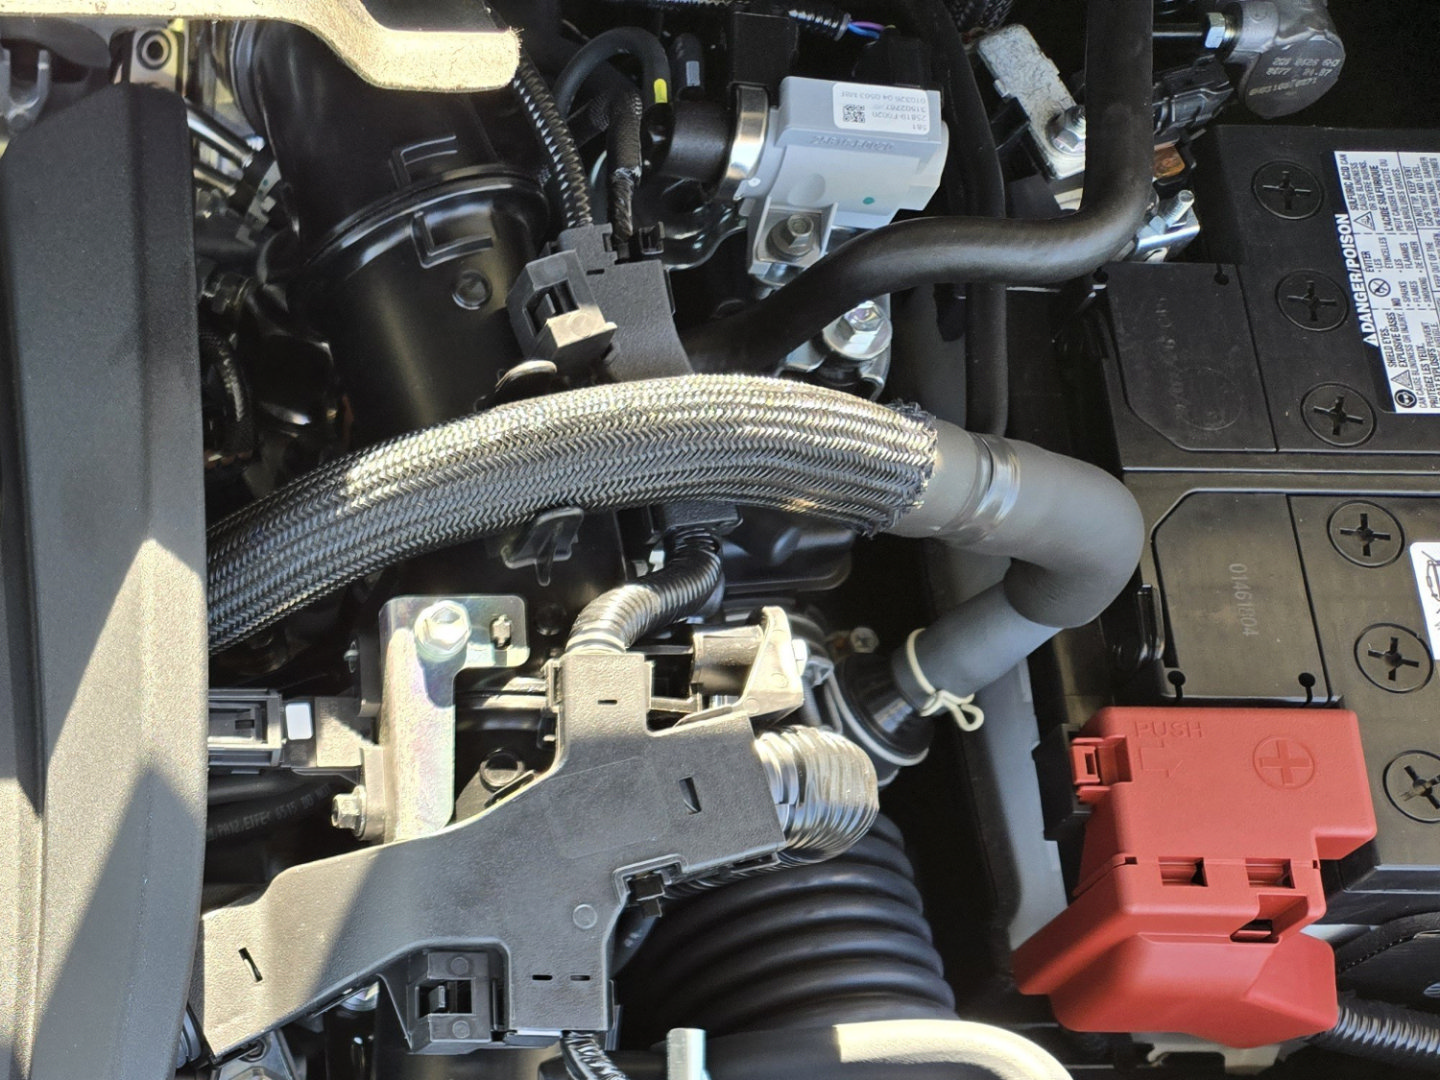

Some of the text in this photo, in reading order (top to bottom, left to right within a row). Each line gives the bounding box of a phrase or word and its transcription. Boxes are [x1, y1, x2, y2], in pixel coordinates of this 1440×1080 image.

[1359, 160, 1370, 180] BURNS.
[1403, 166, 1413, 179] VENT
[1413, 164, 1423, 181] LEVEL.
[1340, 154, 1359, 210] SULFURIC ACID CAN
[1350, 162, 1368, 210] CAUSE BLINDNESS
[1407, 181, 1417, 194] KEEP
[1417, 183, 1425, 194] AND
[1364, 182, 1375, 201] SEVERE
[1369, 165, 1393, 231] L'ACIDE SULFURIQUE
[1388, 196, 1399, 216] CAUSER
[1413, 206, 1422, 217] NOT
[1393, 218, 1403, 231] PEUT
[1403, 221, 1414, 231] DES
[1417, 218, 1425, 226] DO
[1424, 212, 1433, 226] CAPS
[1400, 243, 1413, 269] FLAMMES
[1410, 241, 1424, 269] DE FUMER
[1425, 243, 1434, 251] THE
[1373, 259, 1382, 268] LES
[1394, 259, 1403, 269] LES
[1428, 253, 1437, 261] OF
[1334, 214, 1376, 333] DANGER/POISON
[1430, 263, 1439, 272] OUT
[1399, 281, 1411, 302] SPARKS
[1409, 281, 1420, 302] FLAMES
[1419, 277, 1432, 302] SMOKING
[1391, 298, 1401, 306] NO
[1386, 313, 1408, 367] EXPLOSIVE GASES
[1421, 322, 1434, 347] PEUVENT
[1380, 326, 1397, 367] SHIELD EYES.
[1416, 343, 1428, 361] YEUX.
[1397, 312, 1427, 408] CAN CAUSE BLINDNESS OR INJURY.
[1421, 364, 1431, 374] LES
[1134, 720, 1203, 738] PUSH
